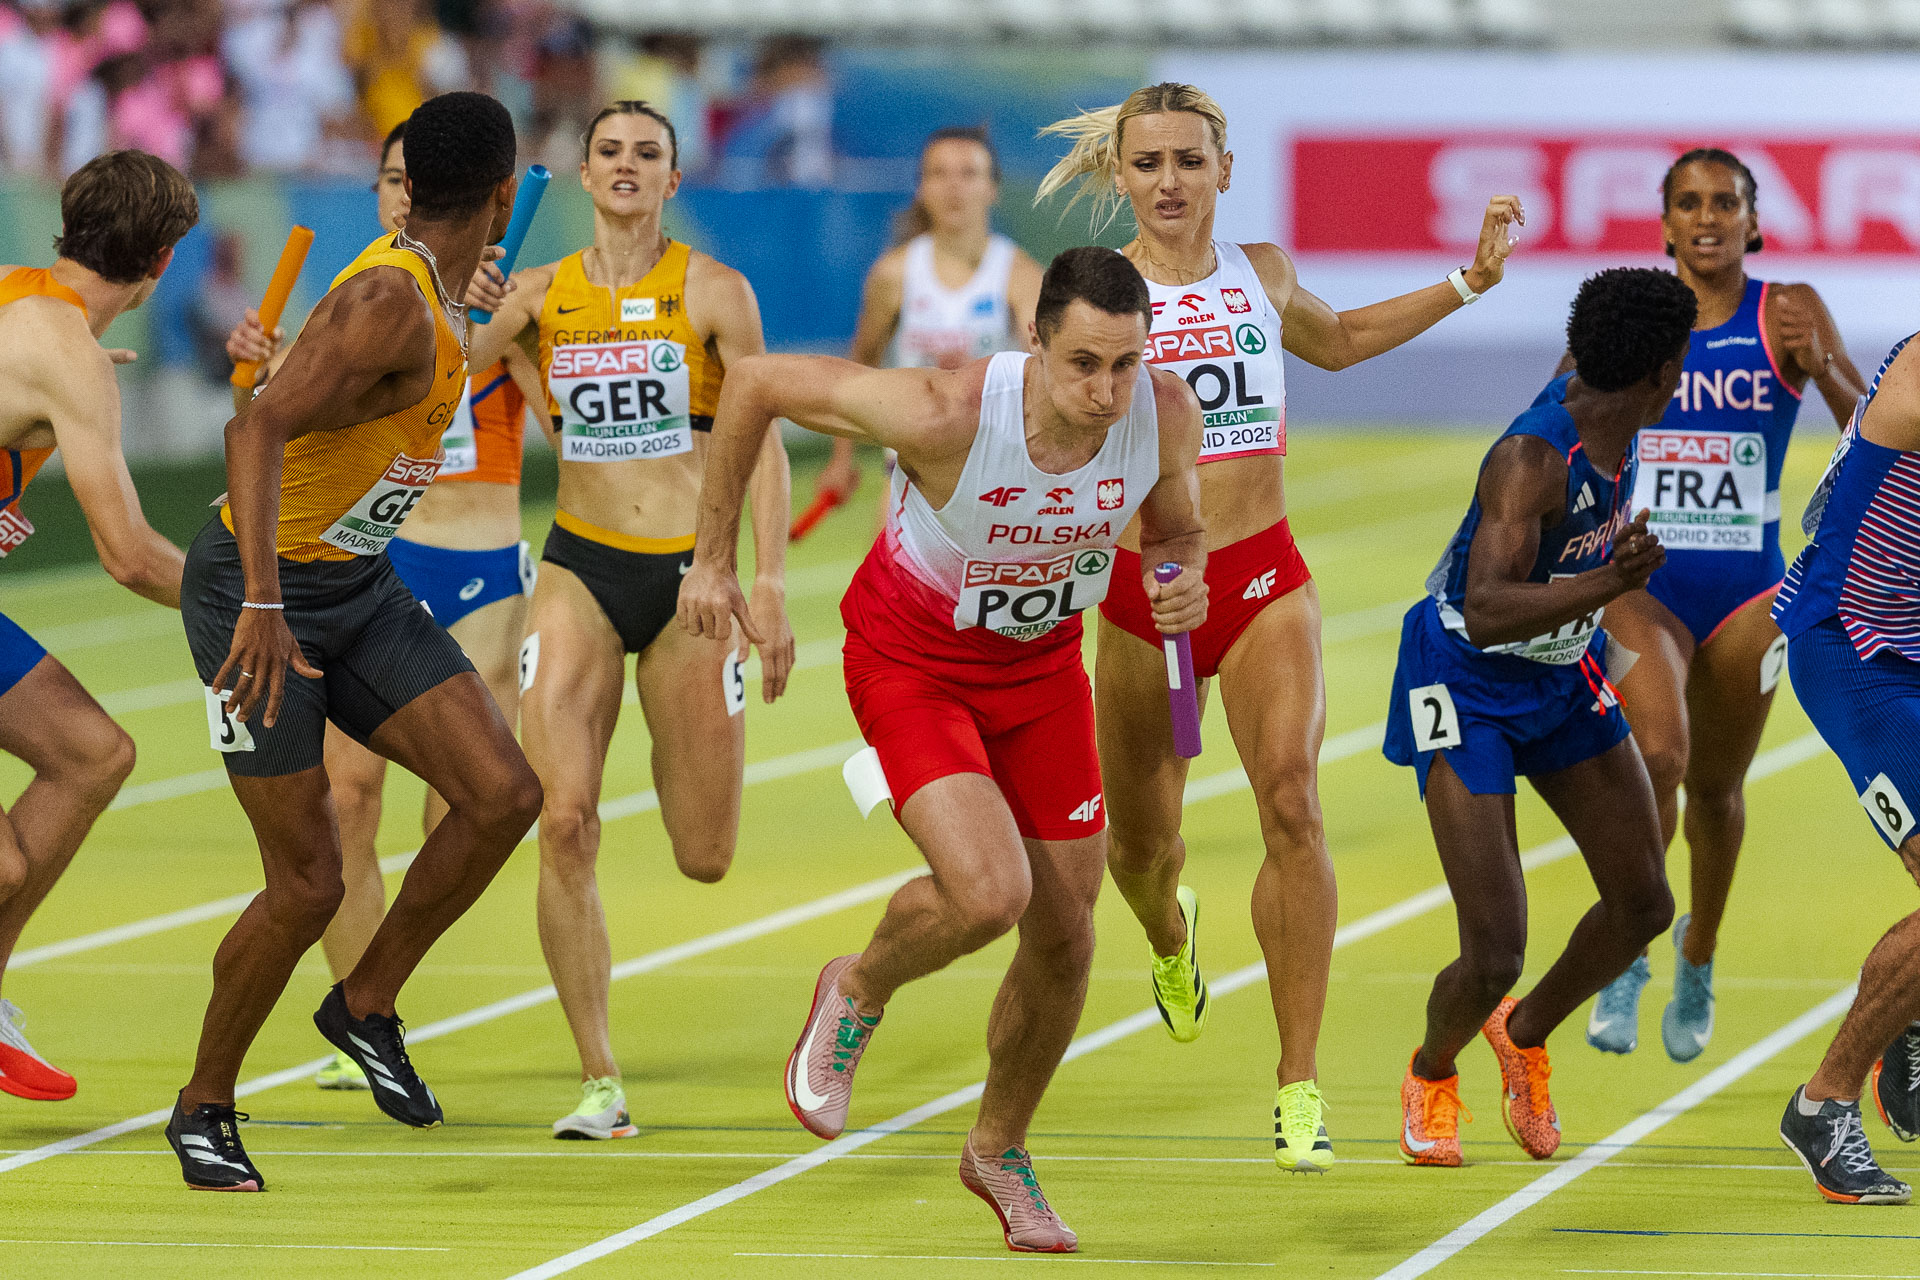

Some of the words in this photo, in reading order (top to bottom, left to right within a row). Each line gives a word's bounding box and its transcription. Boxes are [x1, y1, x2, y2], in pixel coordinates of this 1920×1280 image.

[622, 304, 654, 316] WGV
[1178, 313, 1216, 326] ORLEN
[553, 329, 674, 349] GERMANY
[1142, 330, 1232, 361] SPAR
[553, 349, 648, 376] SPAR
[1163, 361, 1264, 411] OL
[569, 379, 672, 425] GER
[615, 422, 658, 437] CLEAN
[1229, 426, 1273, 446] 2025
[570, 441, 637, 457] MADRID
[642, 433, 682, 454] 2025
[1640, 436, 1729, 462] SPAR
[978, 486, 1028, 508] 4F
[1654, 469, 1743, 510] FRA
[1037, 506, 1075, 516] ORLEN
[333, 530, 385, 551] MADRID
[363, 523, 385, 536] RUN
[987, 521, 1111, 545] POLSKA
[1711, 529, 1751, 545] 2025
[967, 560, 1071, 584] SPAR
[1242, 568, 1277, 600] 4F
[977, 581, 1086, 628] POL
[734, 662, 744, 702] 5
[1422, 696, 1448, 741] 2
[1068, 793, 1102, 823] 4F
[1875, 791, 1903, 833] 8
